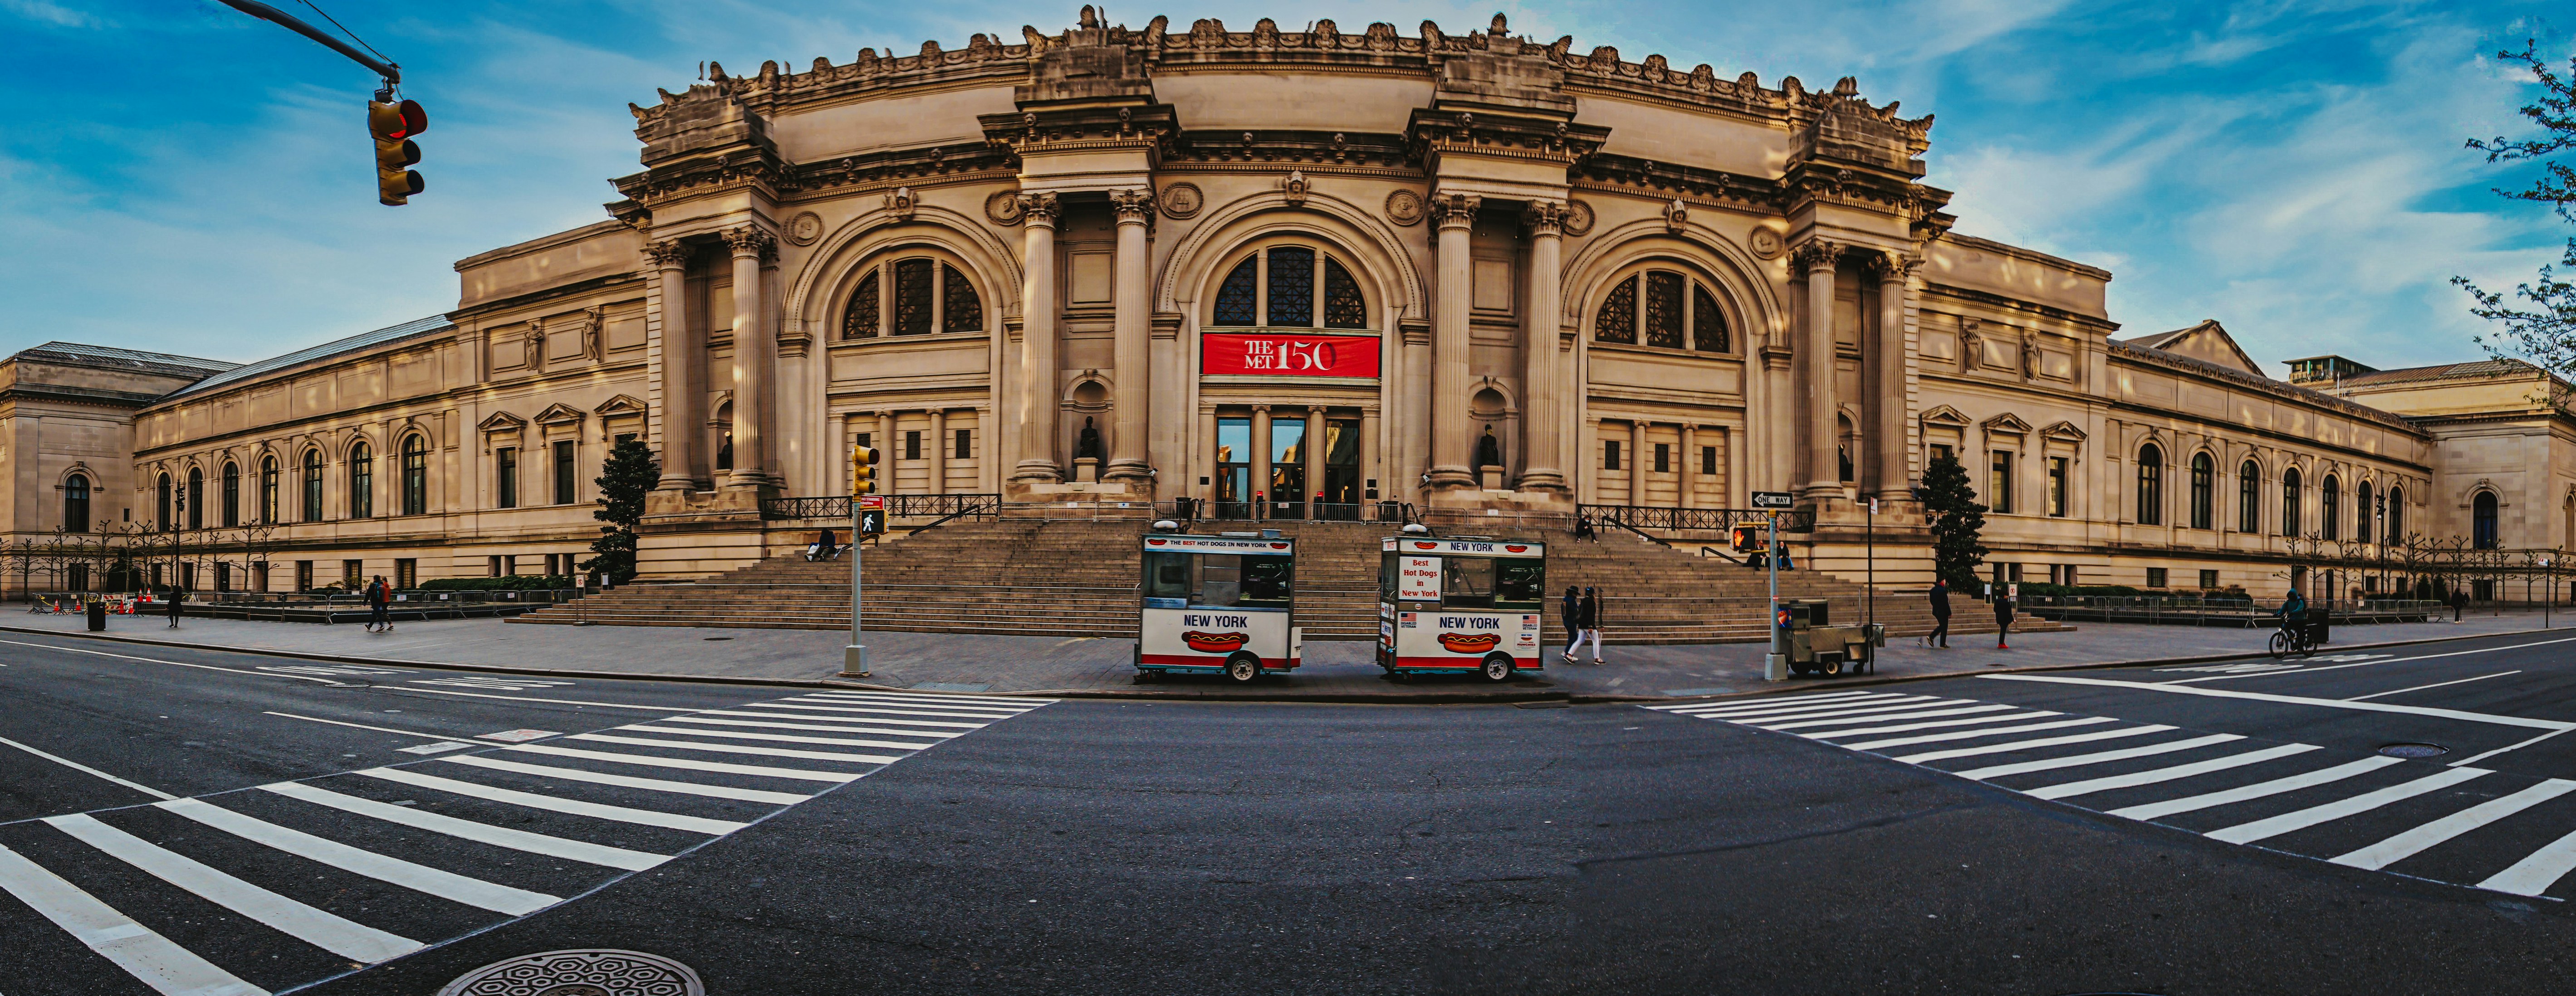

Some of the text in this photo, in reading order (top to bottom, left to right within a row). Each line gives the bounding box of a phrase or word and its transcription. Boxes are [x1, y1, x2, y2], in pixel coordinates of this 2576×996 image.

[1244, 340, 1273, 354] THE
[1244, 355, 1274, 369] MET
[1274, 341, 1337, 371] 150
[1450, 542, 1494, 552] NEW YORK
[1419, 570, 1437, 578] Dogs
[1184, 615, 1248, 628] NEW YORK
[1440, 617, 1500, 629] NEW YORK
[406, 677, 576, 691] BUS
